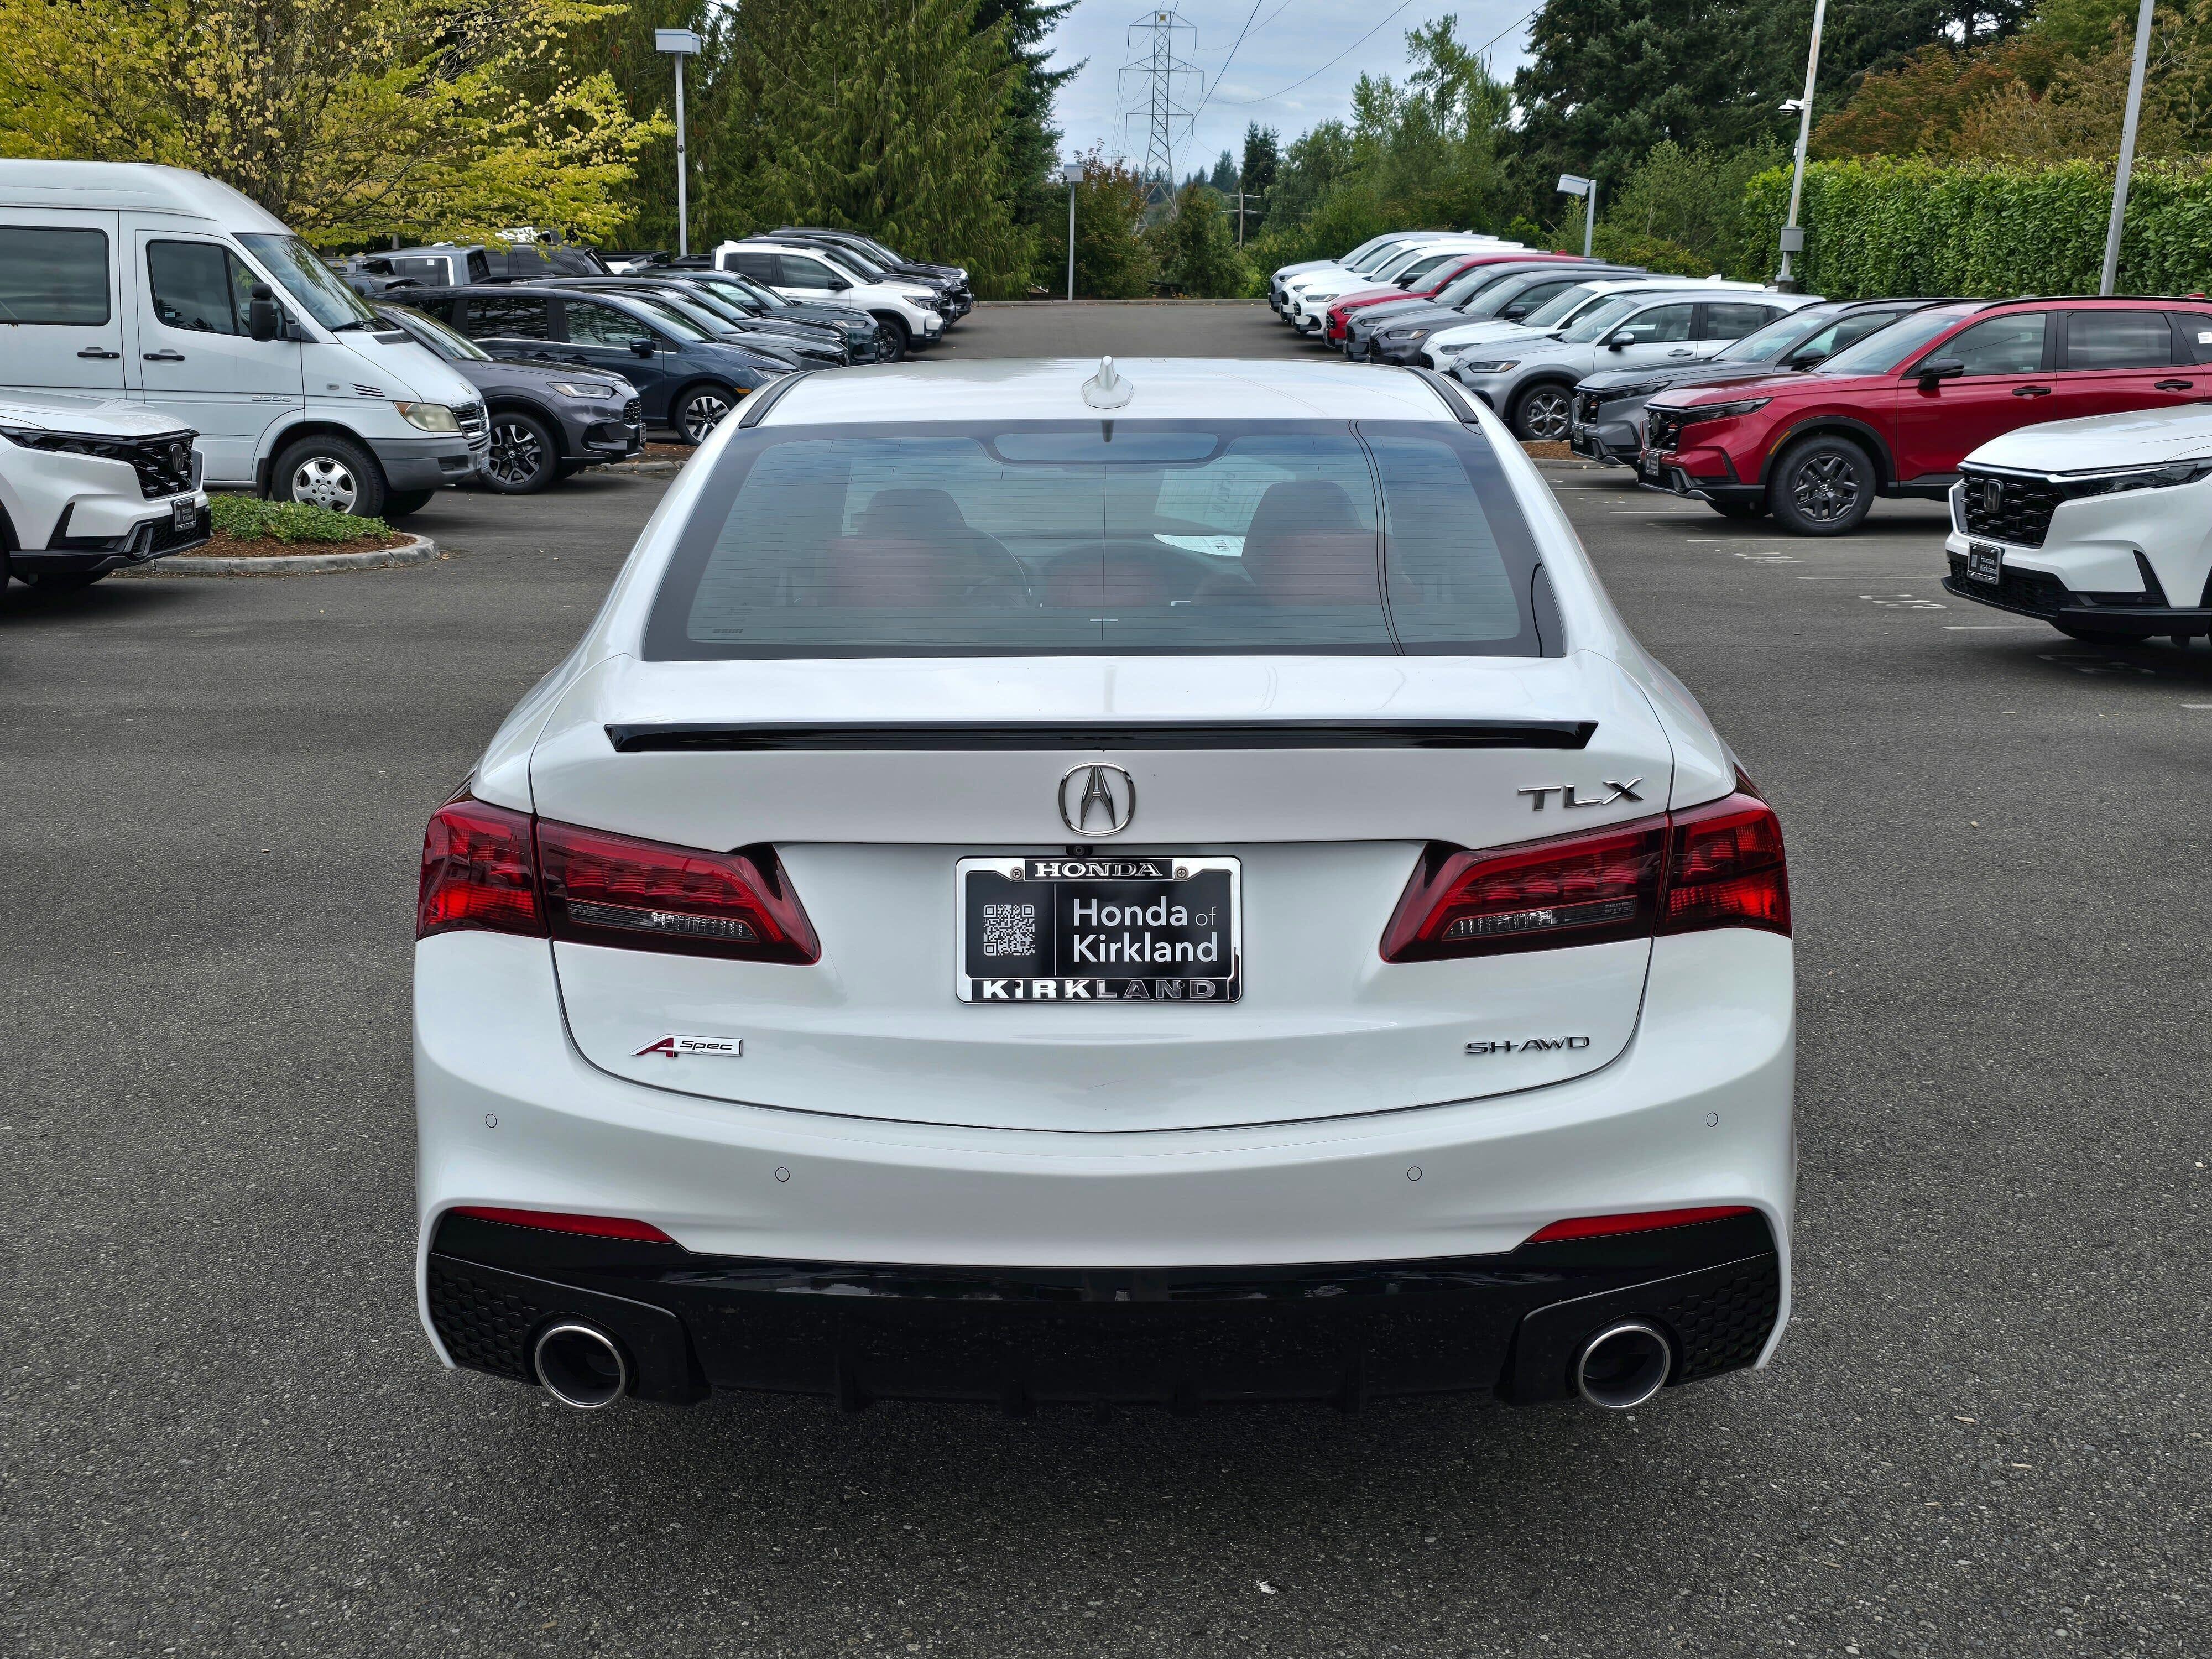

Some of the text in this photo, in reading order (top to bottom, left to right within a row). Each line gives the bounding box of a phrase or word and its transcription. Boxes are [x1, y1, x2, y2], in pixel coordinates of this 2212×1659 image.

[1517, 777, 1644, 811] TLX
[1034, 862, 1163, 877] HONDA
[1073, 896, 1217, 926] Honda of
[1073, 932, 1218, 962] Kirkland
[982, 980, 1217, 999] KIRKLAND
[1464, 1035, 1590, 1054] SH-AWD
